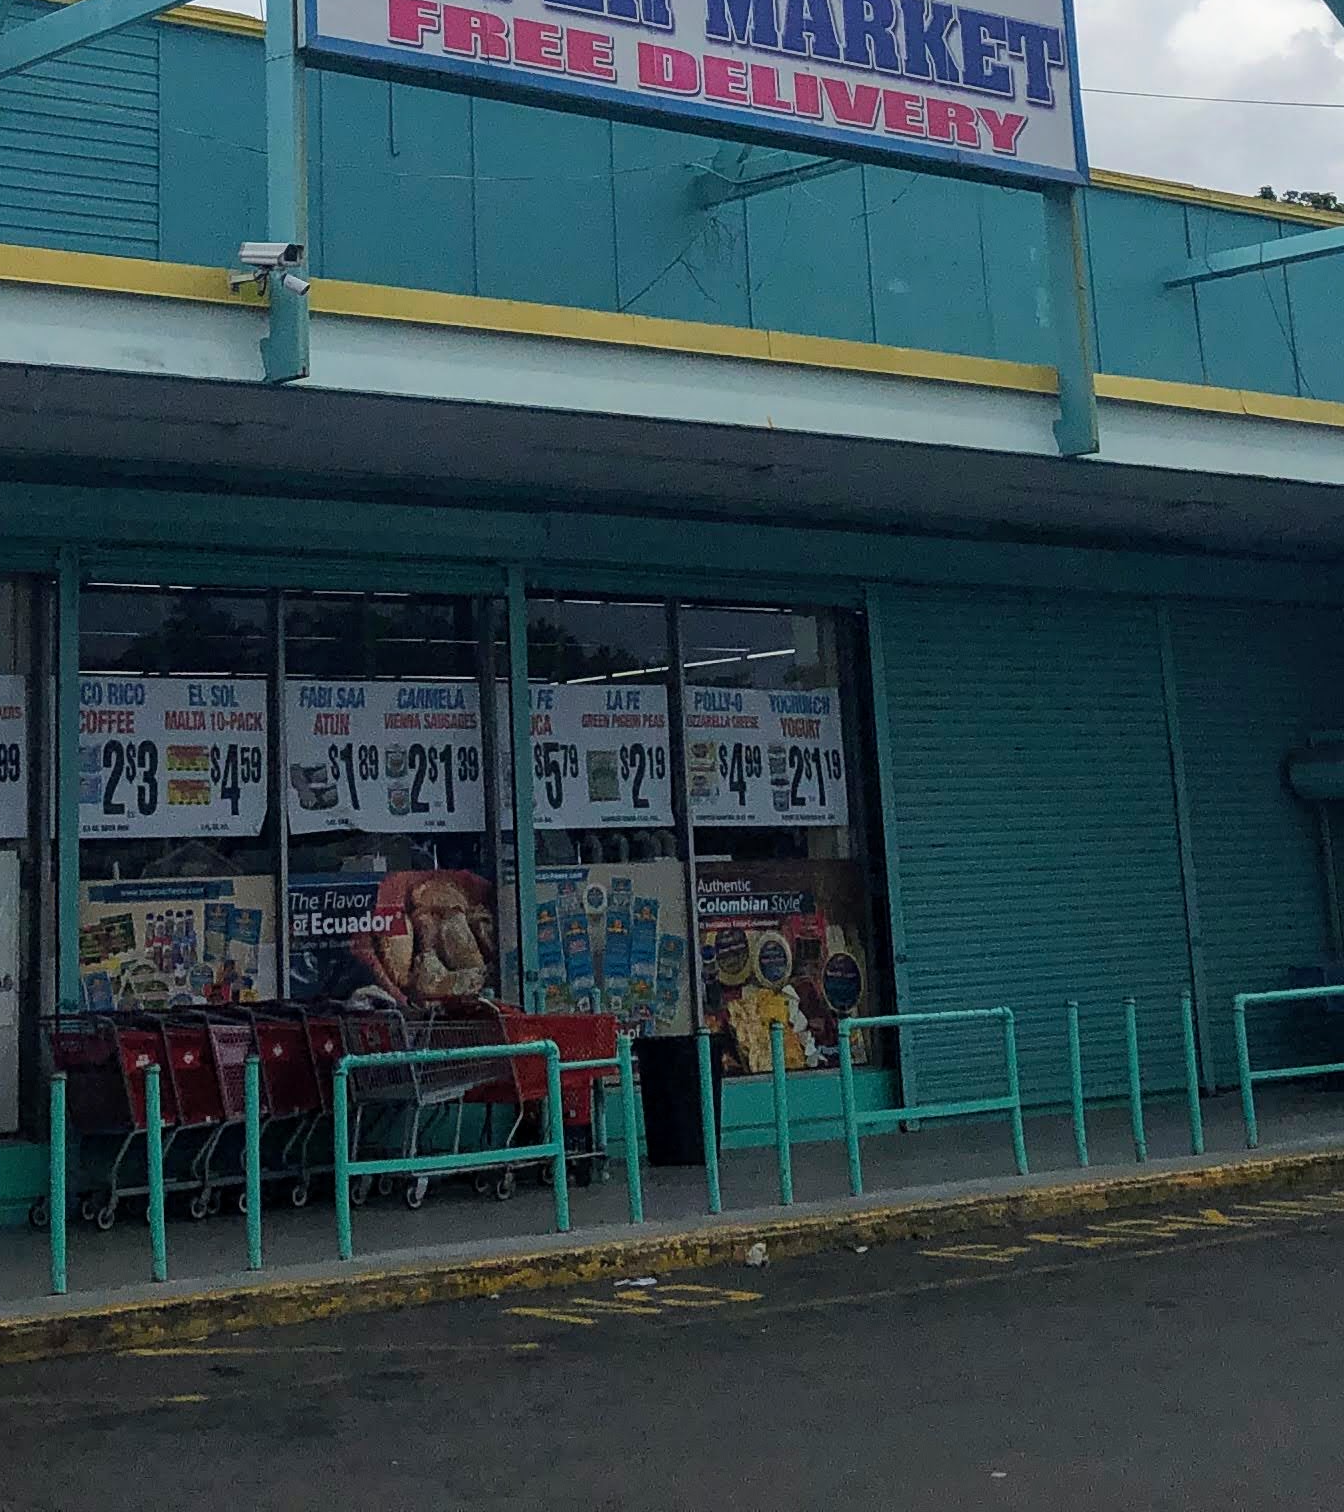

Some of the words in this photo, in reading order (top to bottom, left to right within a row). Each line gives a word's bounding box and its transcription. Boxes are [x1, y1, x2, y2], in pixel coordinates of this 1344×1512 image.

[637, 42, 1028, 155] DELIVERY
[108, 683, 145, 705] RICO
[189, 684, 206, 706] EL
[211, 685, 239, 707] SOL
[537, 689, 554, 710] FE
[606, 690, 623, 710] LA
[627, 690, 641, 710] FE
[694, 691, 743, 712] POLLY-O
[164, 711, 206, 730] MALTA
[313, 713, 350, 735] ATUN
[384, 713, 421, 729] VIENNA
[424, 713, 477, 729] SAUSAGES
[582, 714, 609, 728] GREEN
[643, 714, 665, 728] PEAS
[780, 717, 821, 738] YOGURT
[697, 878, 751, 893] Authentic
[289, 892, 320, 910] The
[323, 891, 372, 909] Flavor
[697, 896, 768, 913] Colombian
[771, 895, 800, 912] Style
[311, 910, 394, 935] Ecuador
